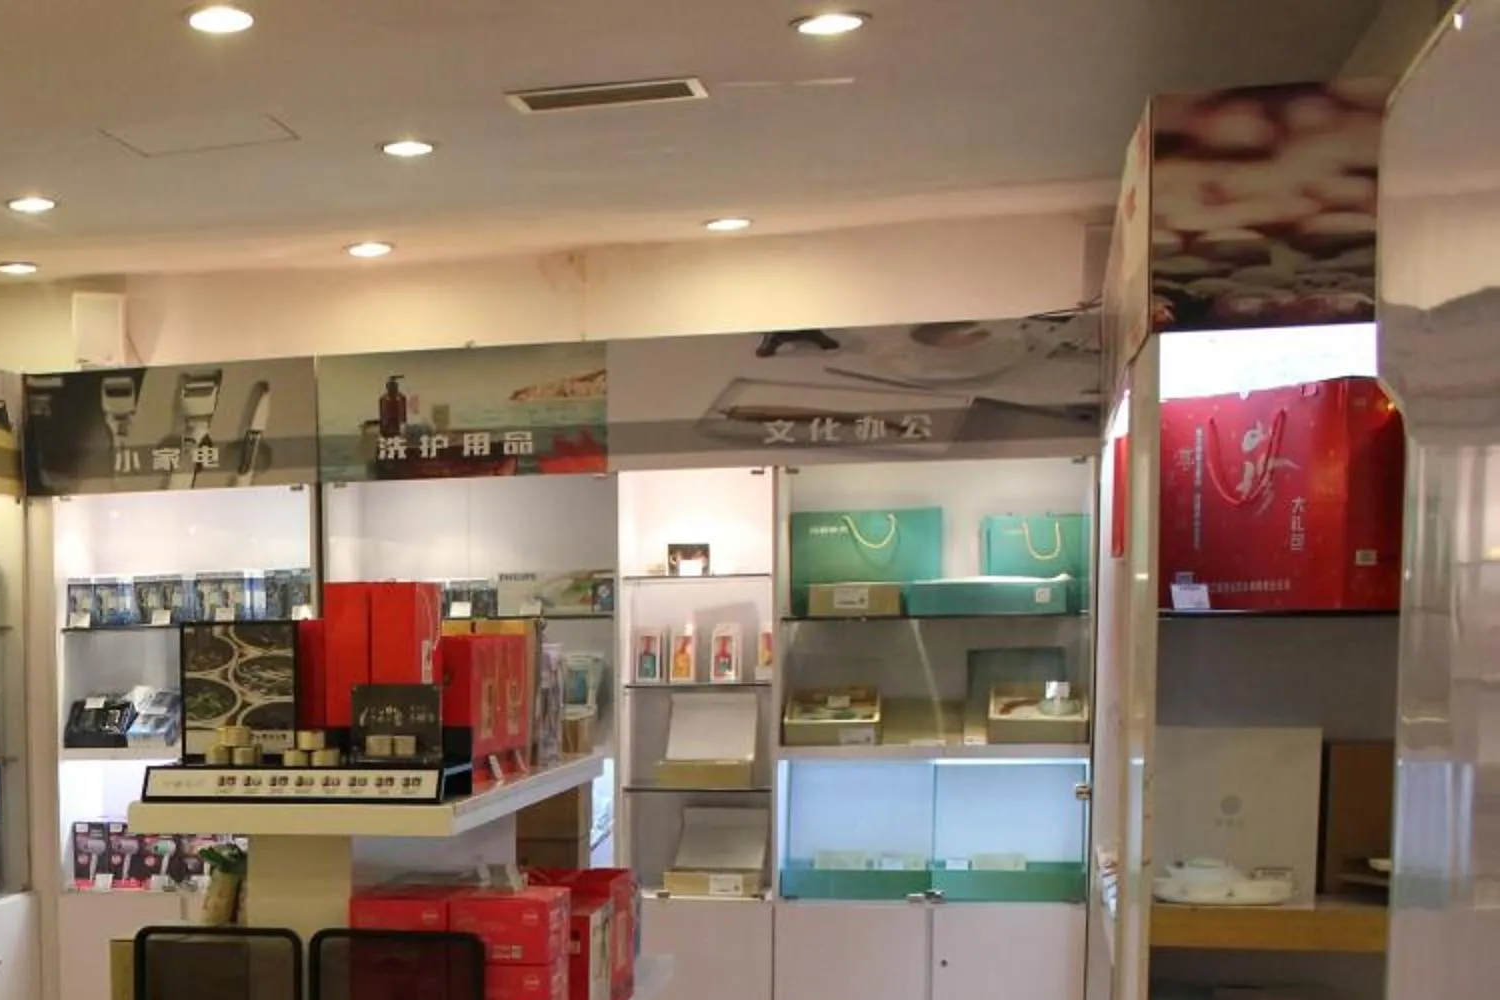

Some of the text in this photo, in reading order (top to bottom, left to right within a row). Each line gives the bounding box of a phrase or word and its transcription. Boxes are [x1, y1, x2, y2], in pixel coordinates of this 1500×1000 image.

[763, 413, 933, 444] 文化办公
[114, 447, 220, 473] 小家电
[378, 431, 533, 460] 洗护用品
